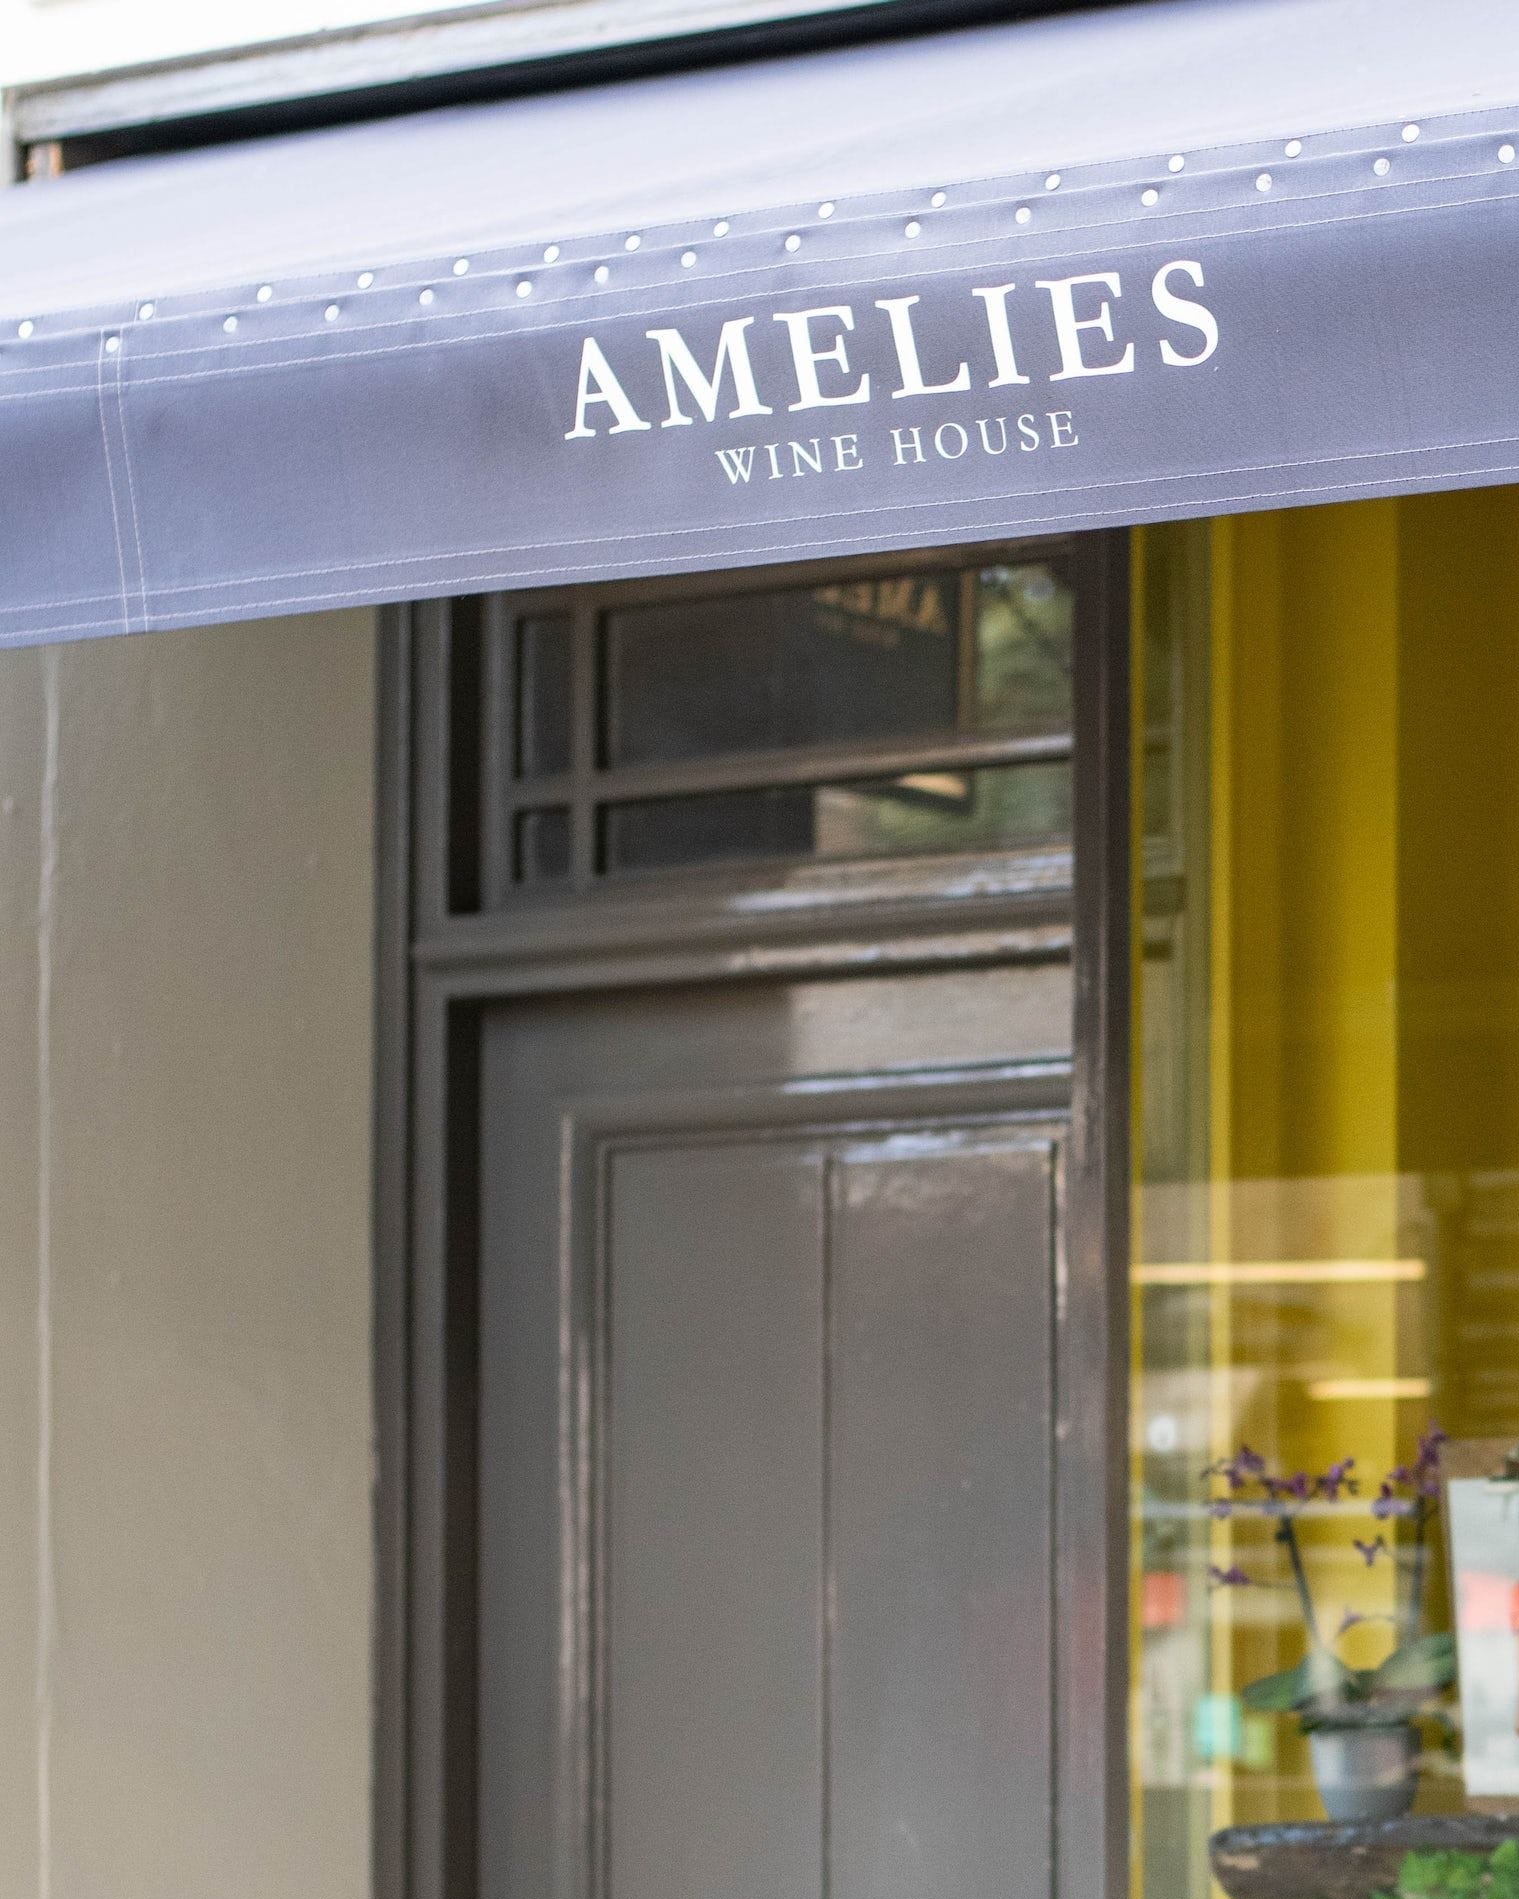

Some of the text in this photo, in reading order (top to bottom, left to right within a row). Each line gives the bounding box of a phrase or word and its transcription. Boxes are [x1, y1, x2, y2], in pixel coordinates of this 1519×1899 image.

[564, 259, 1220, 441] AMELIES
[715, 410, 1080, 486] WINE HOUSE
